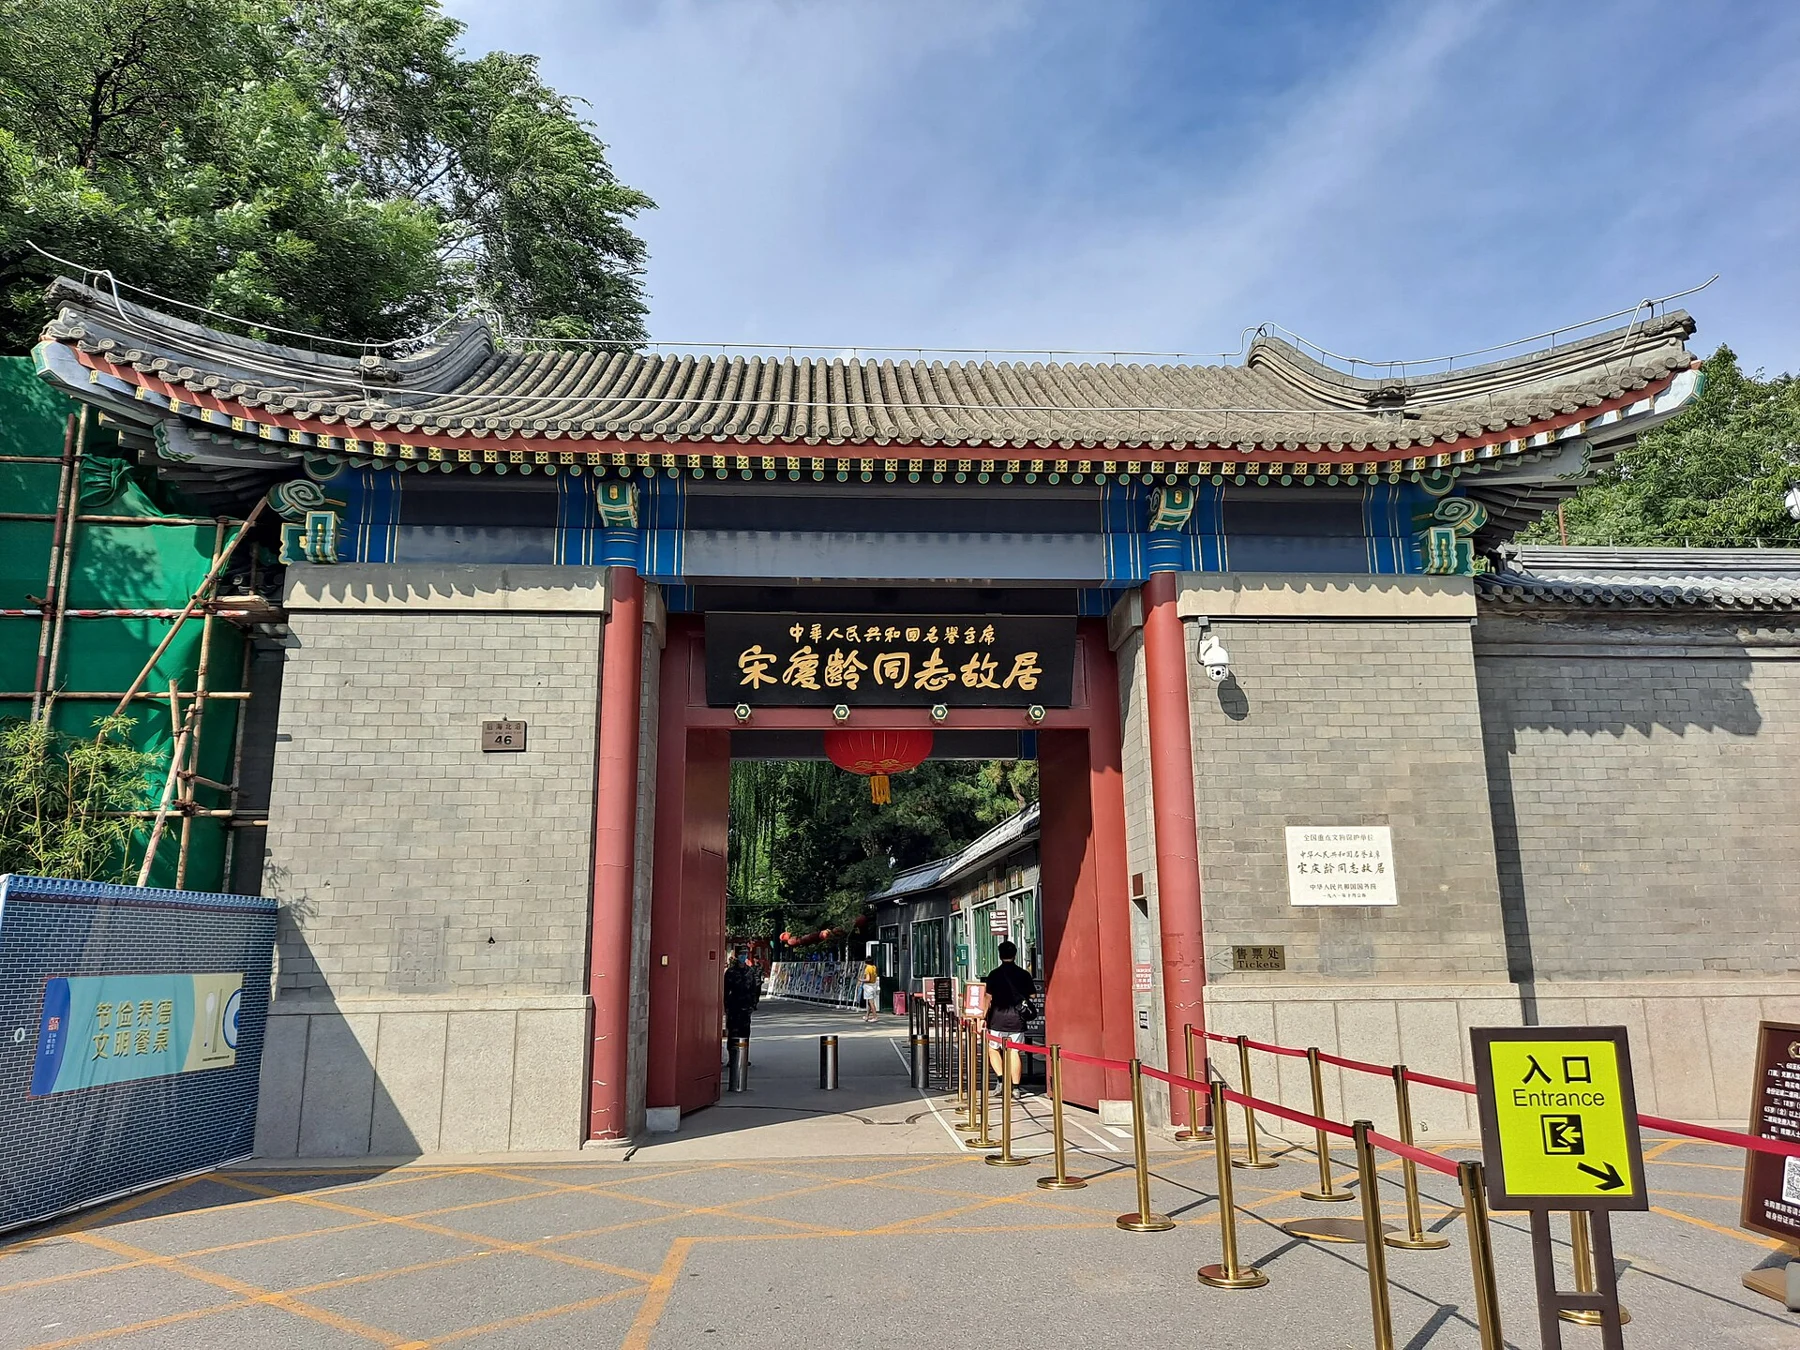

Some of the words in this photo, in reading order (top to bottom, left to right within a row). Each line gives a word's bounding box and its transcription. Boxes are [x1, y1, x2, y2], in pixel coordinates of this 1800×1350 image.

[738, 645, 1043, 692] 宋慶齡同志故居
[494, 735, 512, 745] 46
[1236, 947, 1279, 960] 售票处
[1237, 960, 1280, 968] Tickets
[96, 1000, 172, 1031] 节俭养德
[91, 1027, 169, 1061] 文明餐桌
[1521, 1054, 1592, 1085] 入口
[1513, 1088, 1605, 1107] Entrance
